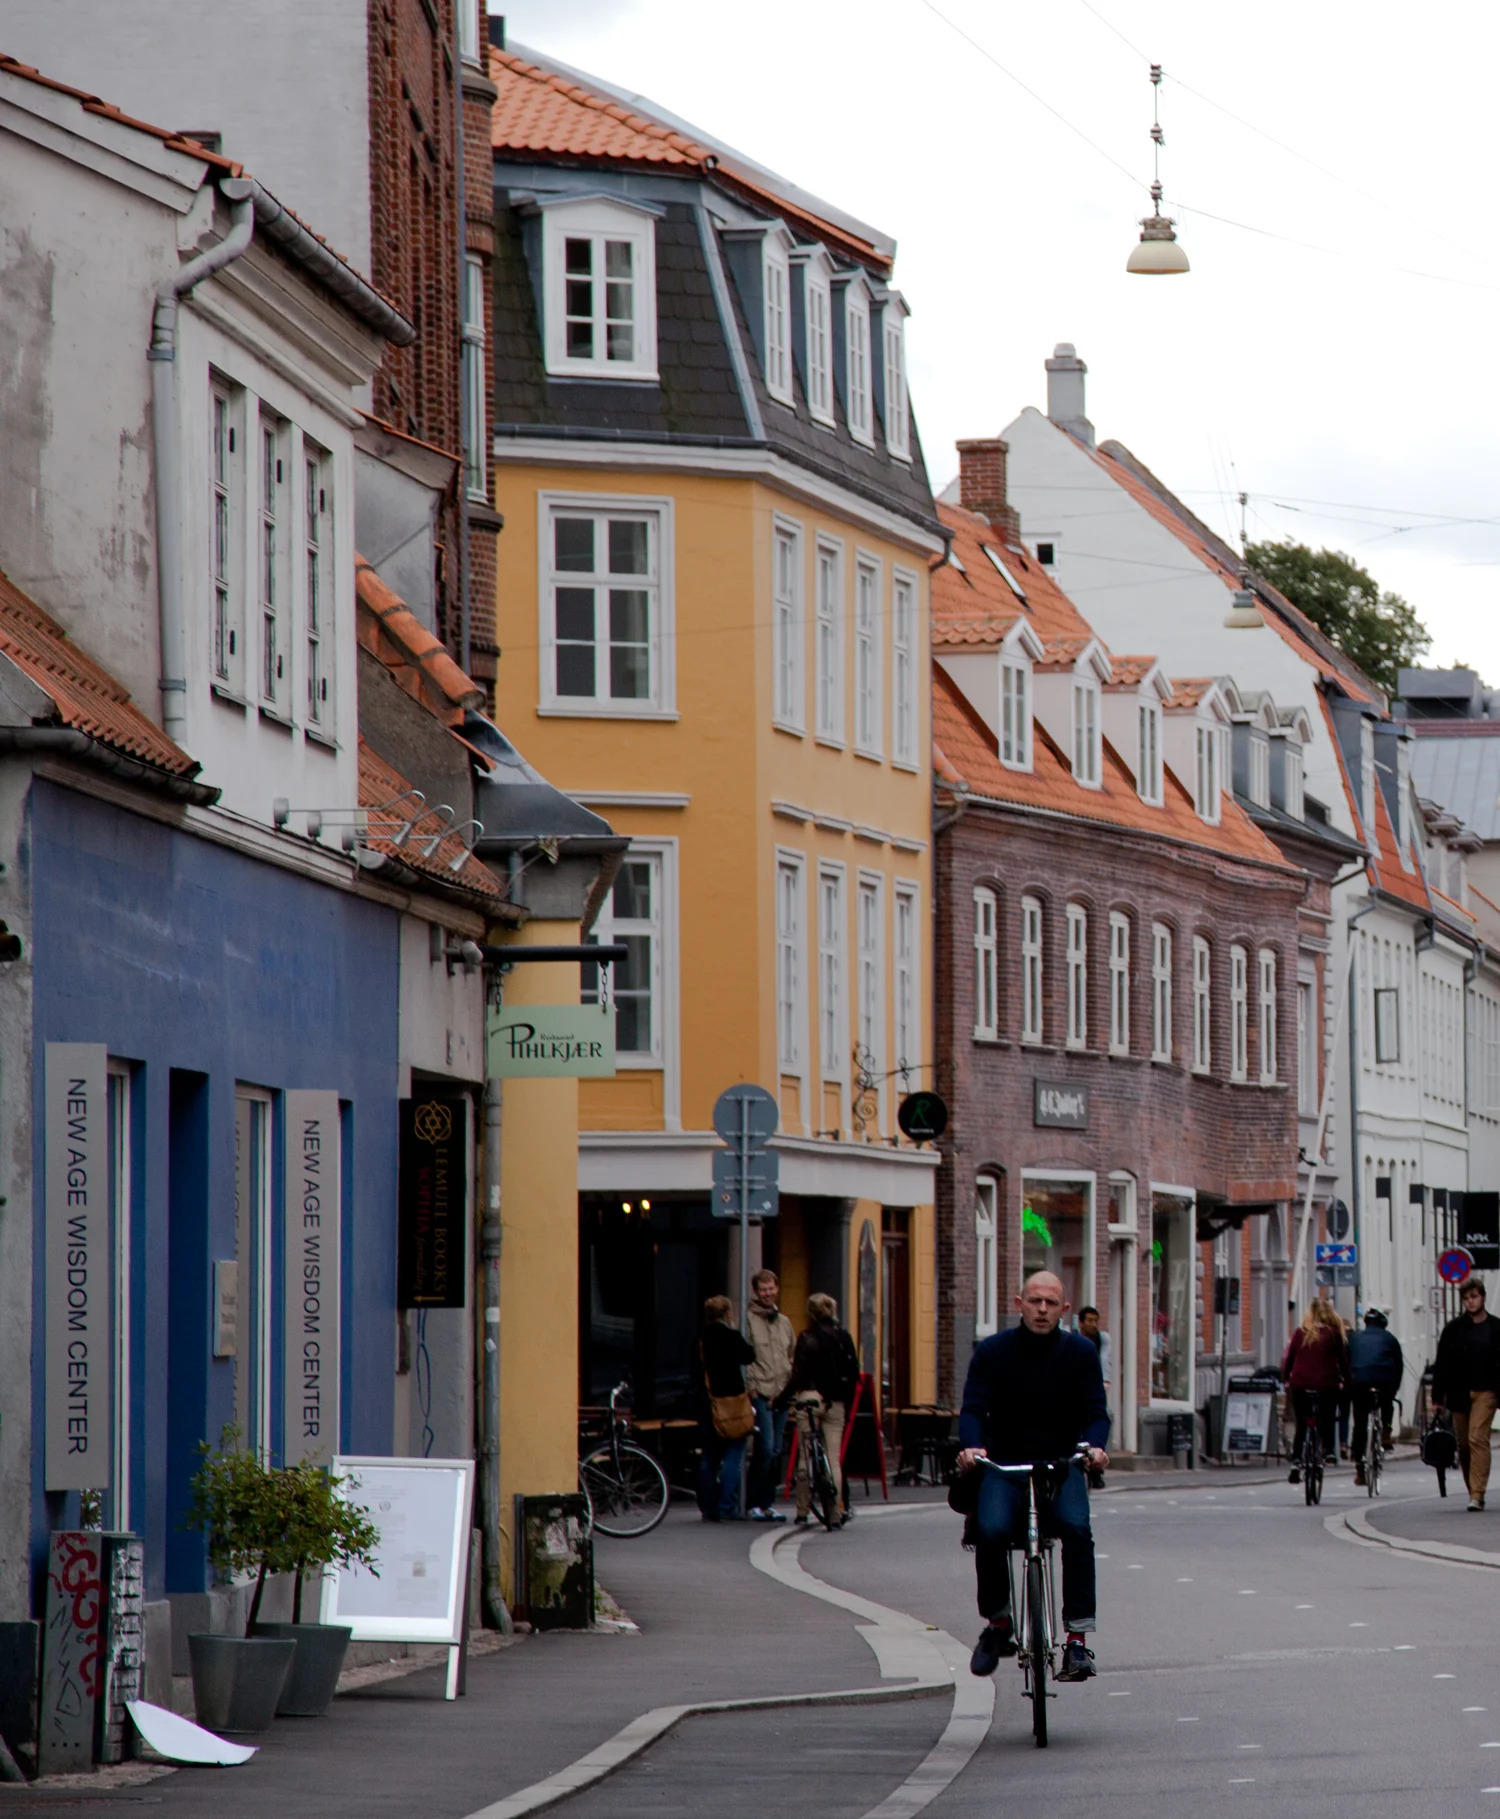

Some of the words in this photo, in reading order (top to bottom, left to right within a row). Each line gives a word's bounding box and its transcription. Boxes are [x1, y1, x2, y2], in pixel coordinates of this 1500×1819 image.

[67, 1077, 87, 1142] NEW
[67, 1147, 87, 1207] AGE
[303, 1119, 320, 1174] NEW
[303, 1178, 320, 1228] AGE
[434, 1147, 450, 1222] LEMUEL
[67, 1214, 87, 1332] WISDOM
[303, 1234, 320, 1334] WISDOM
[433, 1227, 448, 1292] BOOKS
[67, 1340, 88, 1456] CENTER
[303, 1340, 320, 1439] CENTER
